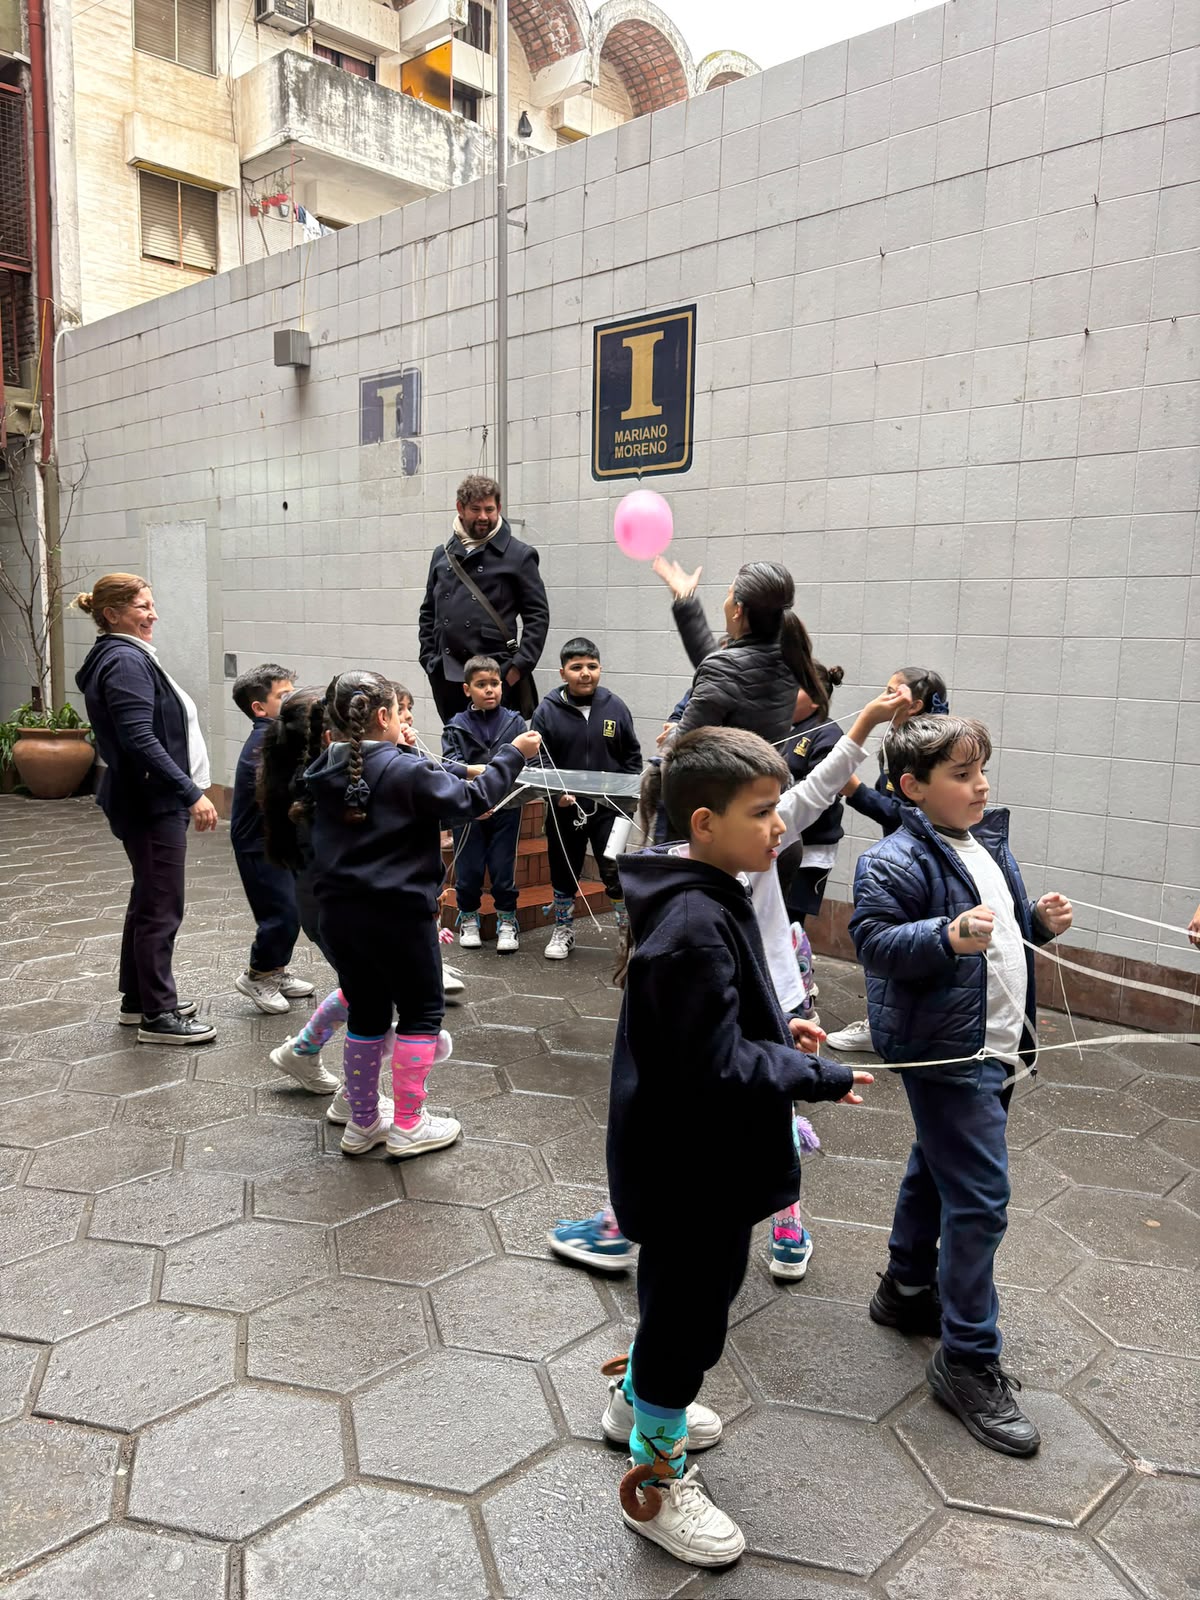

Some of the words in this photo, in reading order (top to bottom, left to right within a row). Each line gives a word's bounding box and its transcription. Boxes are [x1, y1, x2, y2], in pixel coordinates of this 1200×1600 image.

[621, 330, 664, 421] I
[614, 424, 668, 444] MARIANO
[614, 440, 667, 459] MORENO
